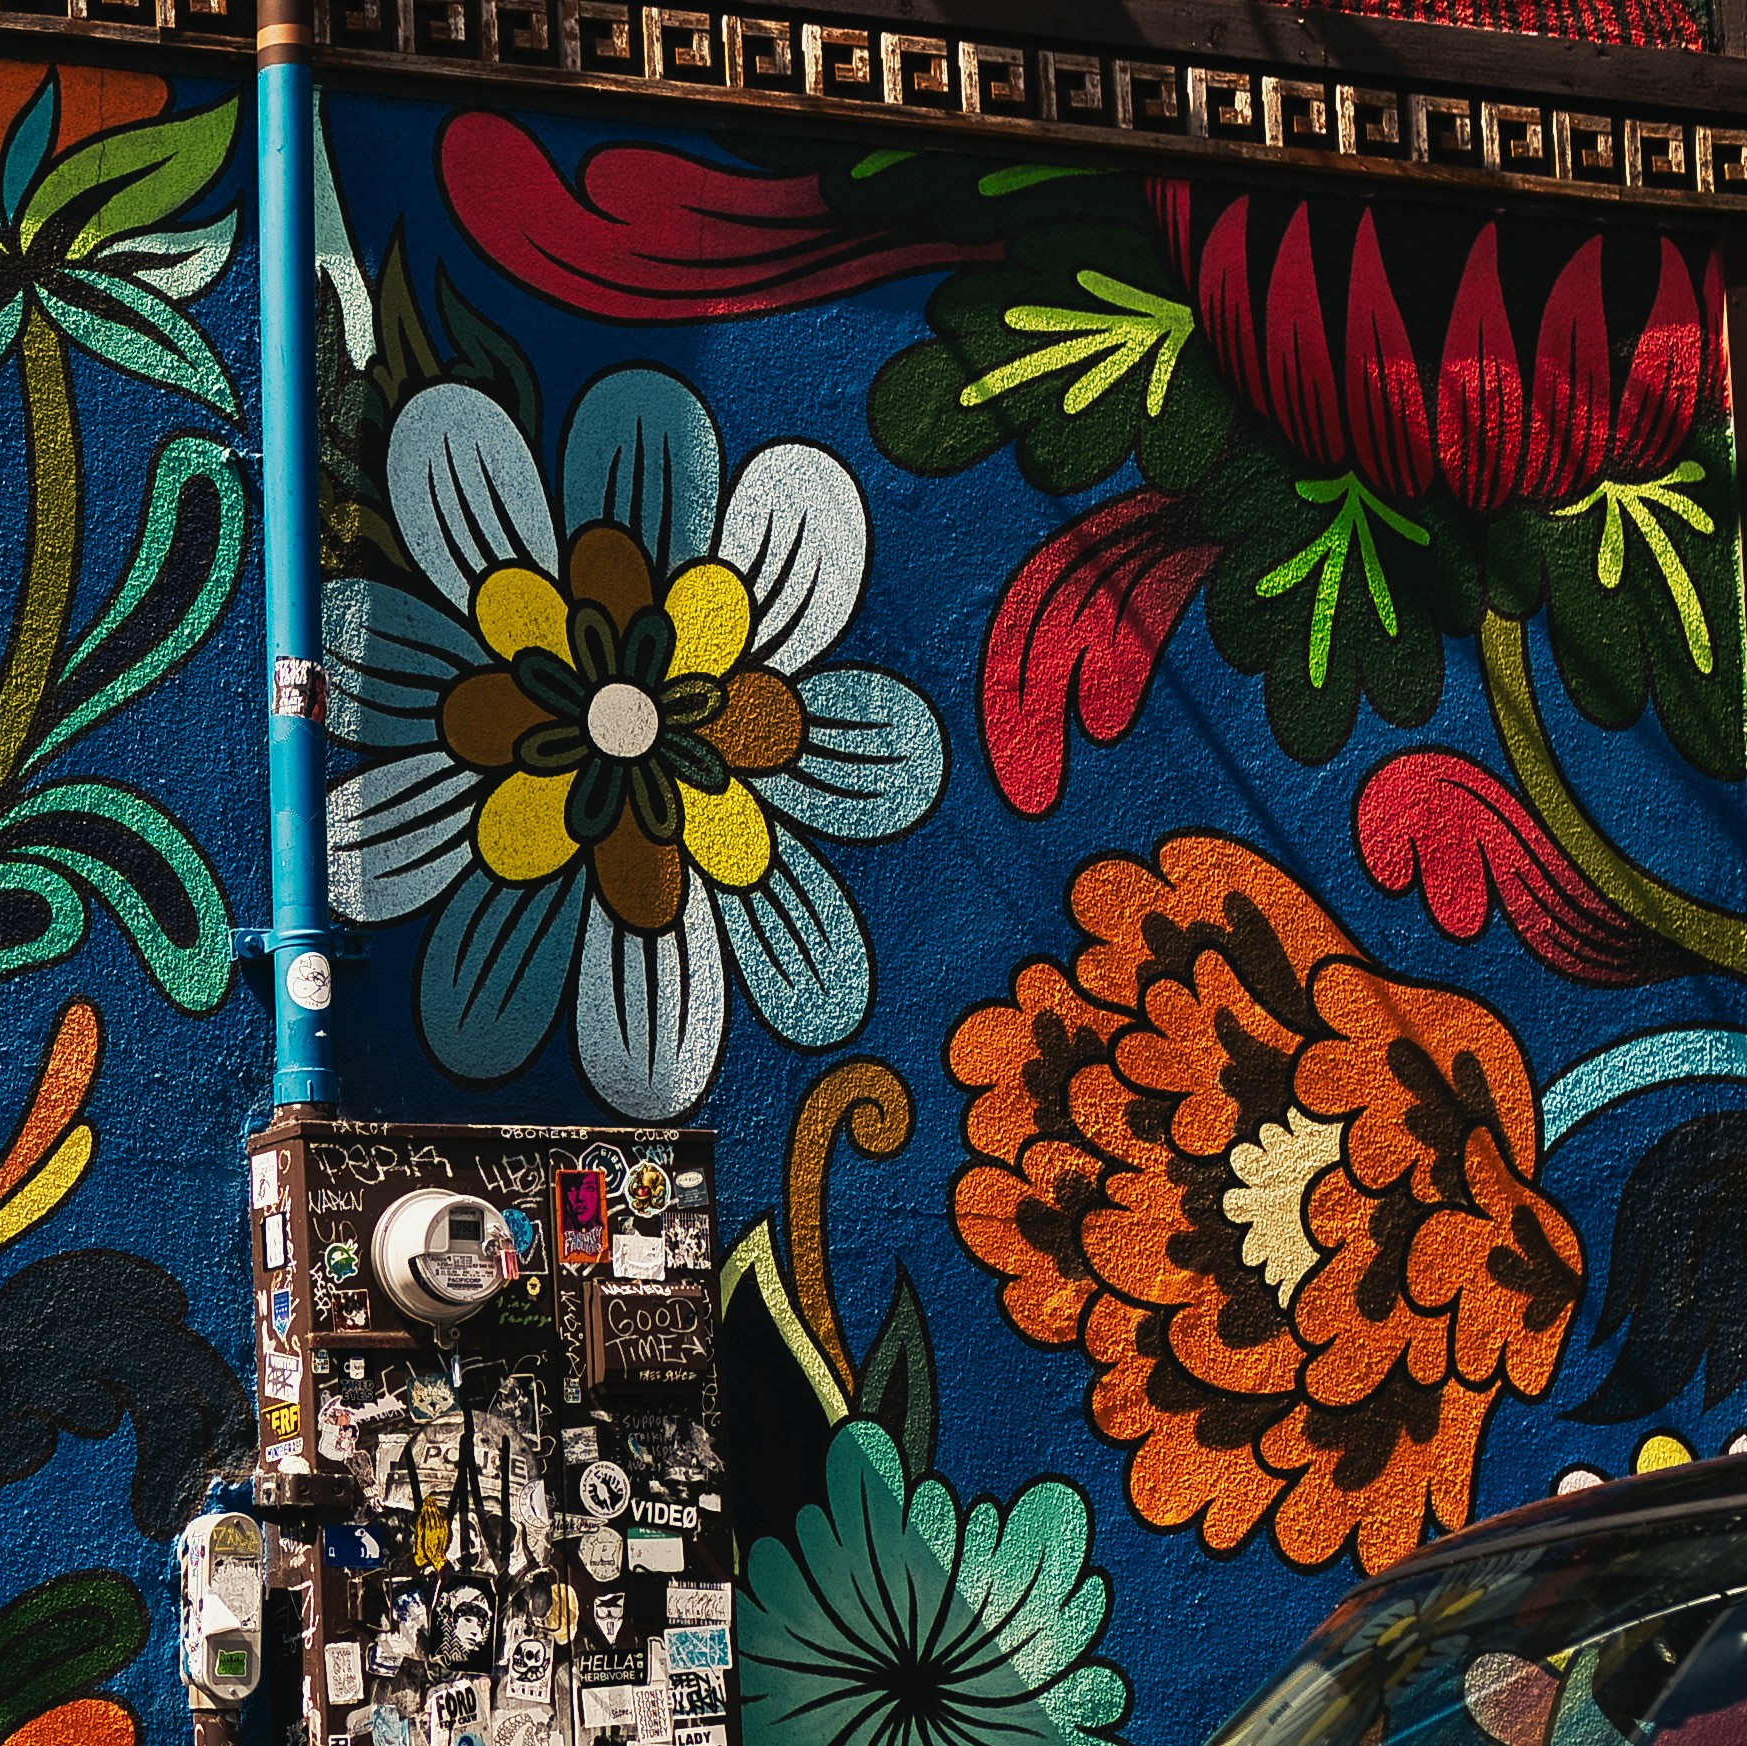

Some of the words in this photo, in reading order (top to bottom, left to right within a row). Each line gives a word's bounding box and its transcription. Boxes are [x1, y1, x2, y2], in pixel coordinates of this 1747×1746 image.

[608, 1298, 698, 1337] GOOD
[605, 1334, 687, 1379] TIME
[340, 1379, 374, 1390] TIRED
[341, 1390, 374, 1401] EYES
[581, 1653, 635, 1671] HELLA
[580, 1670, 636, 1682] HERBIVORE
[436, 1686, 477, 1723] FORD
[677, 1731, 711, 1746] LADY
